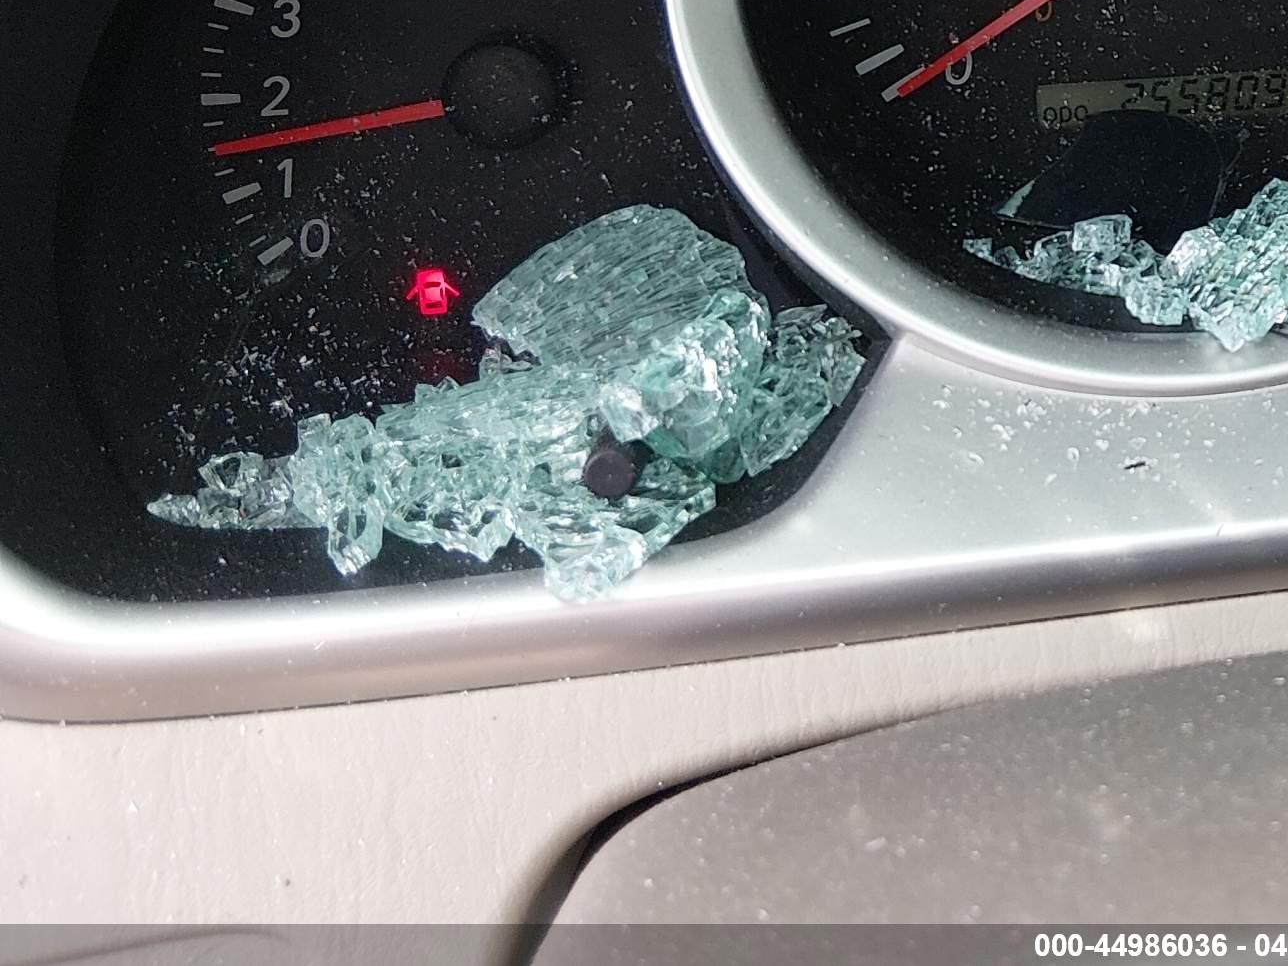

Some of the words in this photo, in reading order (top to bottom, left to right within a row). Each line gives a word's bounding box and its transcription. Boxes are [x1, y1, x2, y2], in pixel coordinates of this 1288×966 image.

[260, 76, 291, 117] 2
[1121, 72, 1287, 114] 255809
[277, 158, 294, 199] 1
[300, 219, 331, 258] 0
